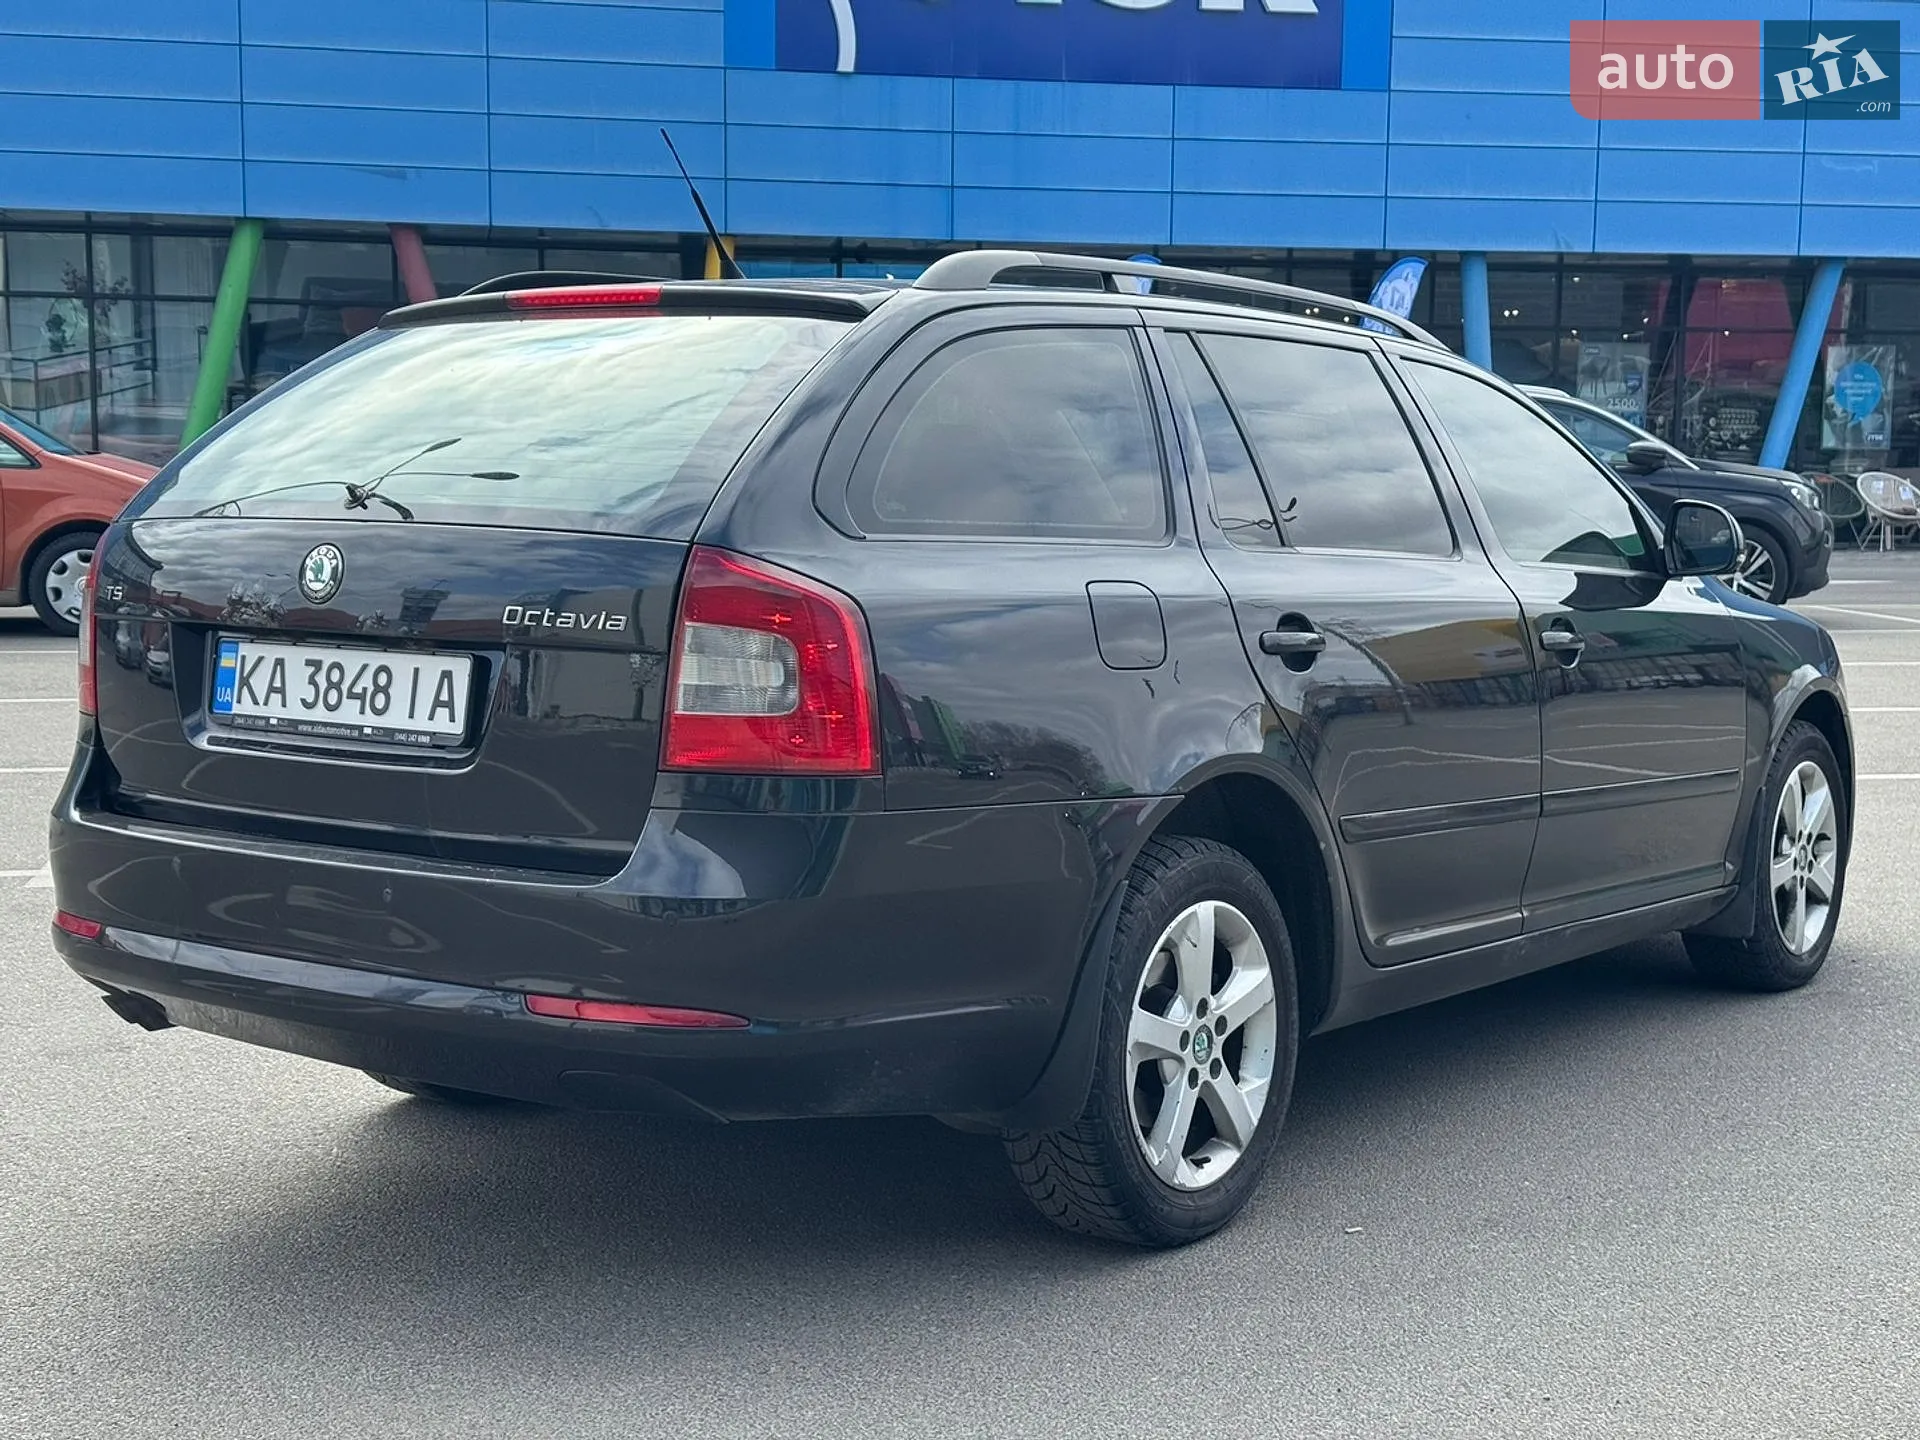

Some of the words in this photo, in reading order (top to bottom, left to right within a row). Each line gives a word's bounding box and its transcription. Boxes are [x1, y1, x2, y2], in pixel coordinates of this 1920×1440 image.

[502, 605, 628, 631] Octavia
[216, 686, 232, 703] UA
[235, 653, 288, 708] KA
[299, 658, 393, 717] 3848
[407, 666, 457, 723] IA
